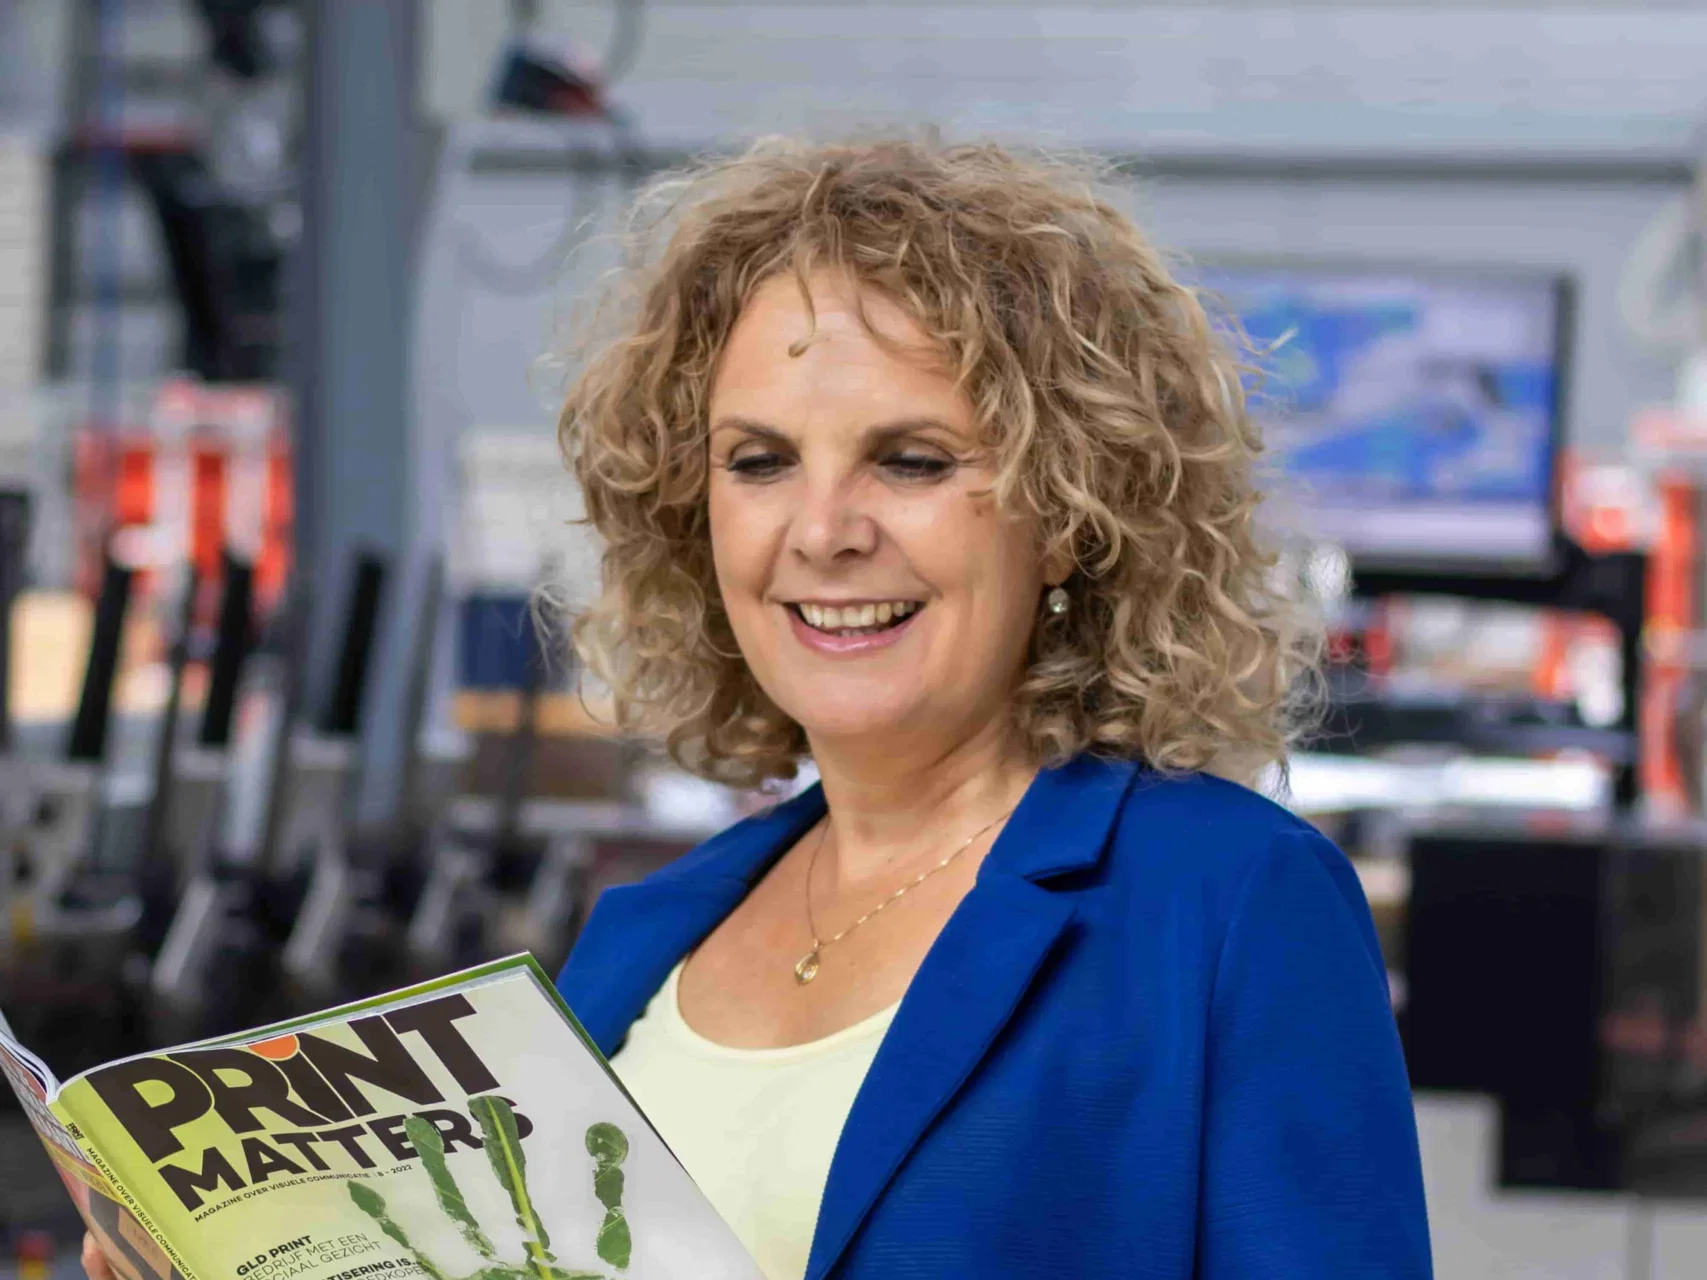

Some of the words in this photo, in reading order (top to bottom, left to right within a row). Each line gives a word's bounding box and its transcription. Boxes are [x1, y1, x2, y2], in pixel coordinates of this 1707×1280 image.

[86, 1148, 117, 1185] MAGAZINE
[116, 1184, 134, 1205] OVER
[133, 1204, 158, 1234] VISUELE
[195, 1196, 243, 1223] MAGAZINE
[243, 1187, 270, 1200] OVER
[270, 1177, 306, 1191] VISUELE
[307, 1172, 371, 1183] COMMUNICATIE
[390, 1164, 413, 1174] 2022
[236, 1254, 268, 1277] GLD
[268, 1235, 314, 1259] PRINT
[305, 1240, 335, 1257] MET
[338, 1233, 368, 1247] EEN
[319, 1241, 382, 1264] GEZICHT
